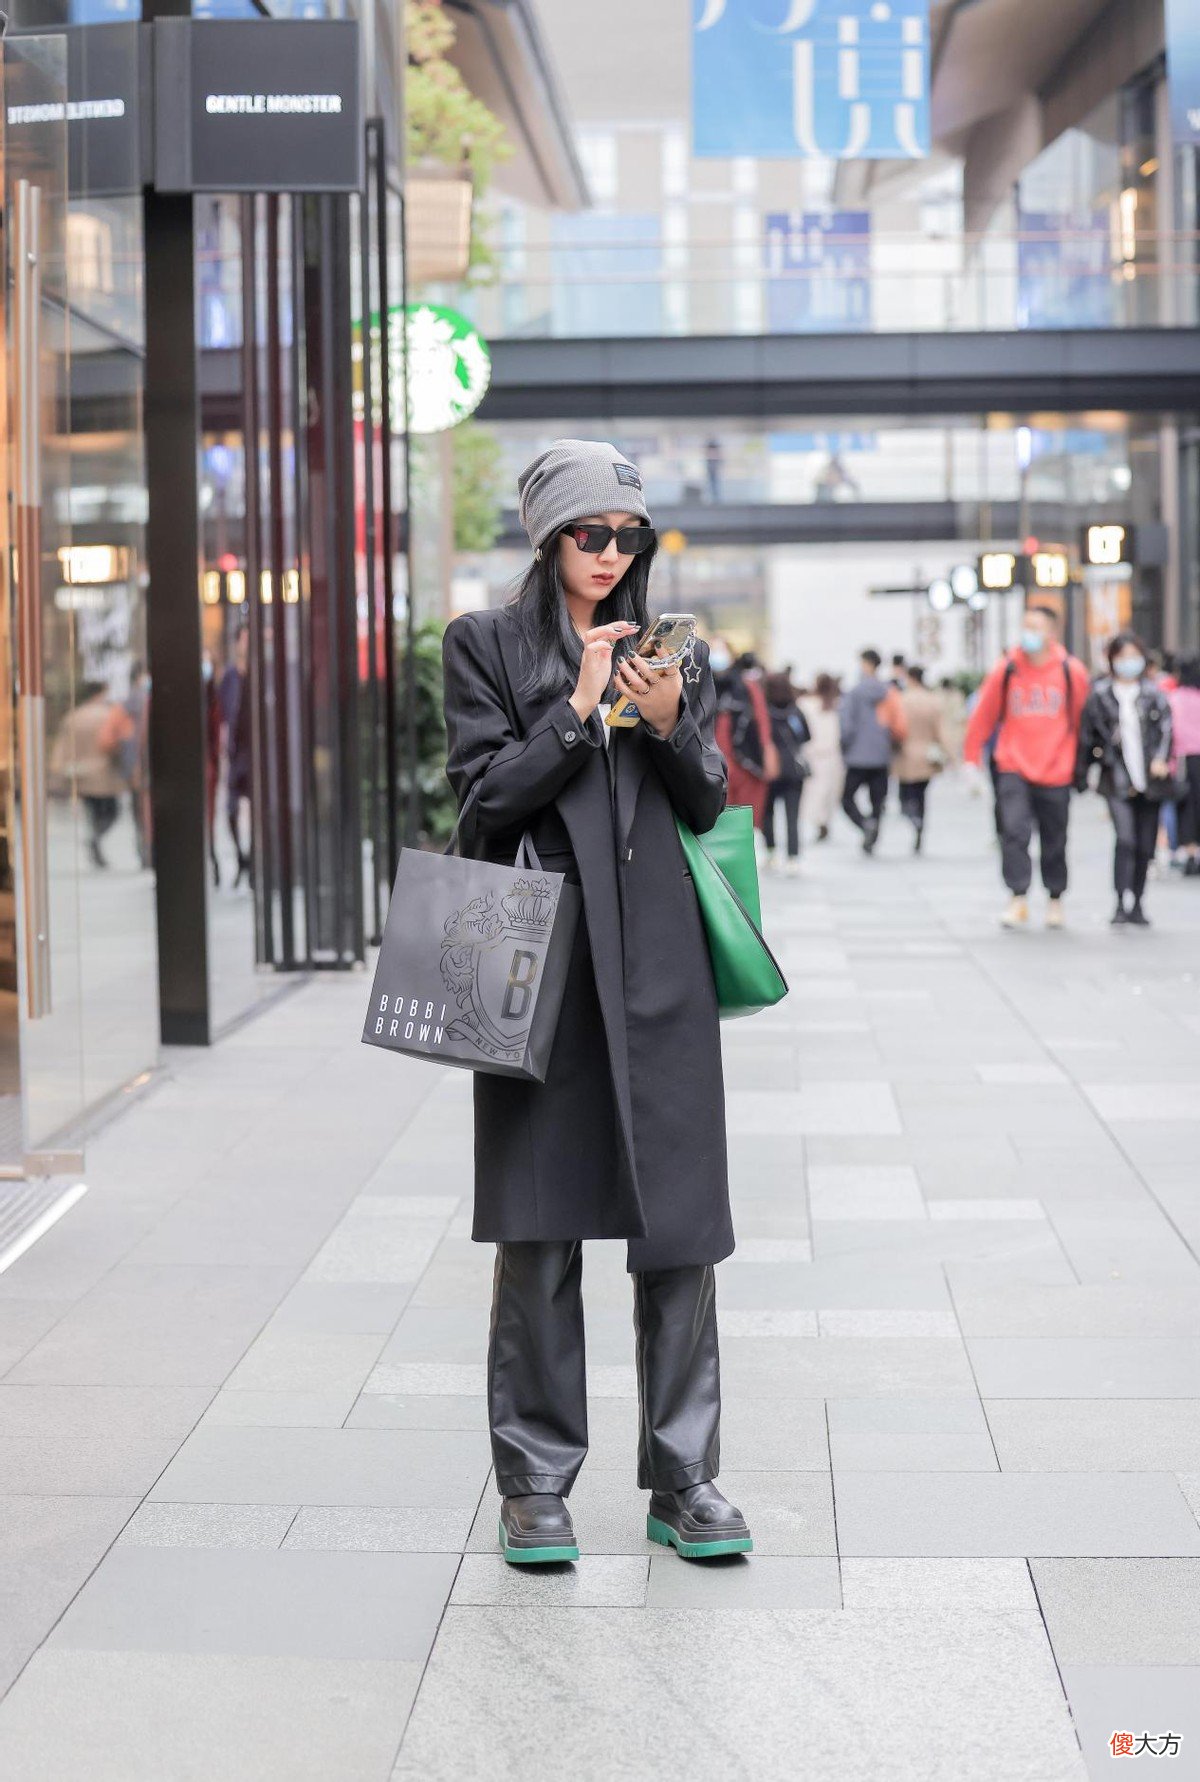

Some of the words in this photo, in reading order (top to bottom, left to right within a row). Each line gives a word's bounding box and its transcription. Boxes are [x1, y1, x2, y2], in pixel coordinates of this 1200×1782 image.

[205, 95, 266, 113] GENTLE
[266, 95, 342, 113] MONSTER
[501, 949, 539, 1021] B
[379, 994, 446, 1021] BOBBI
[374, 1016, 444, 1045] BROWN
[475, 1037, 498, 1055] NEW
[505, 1051, 520, 1059] YO
